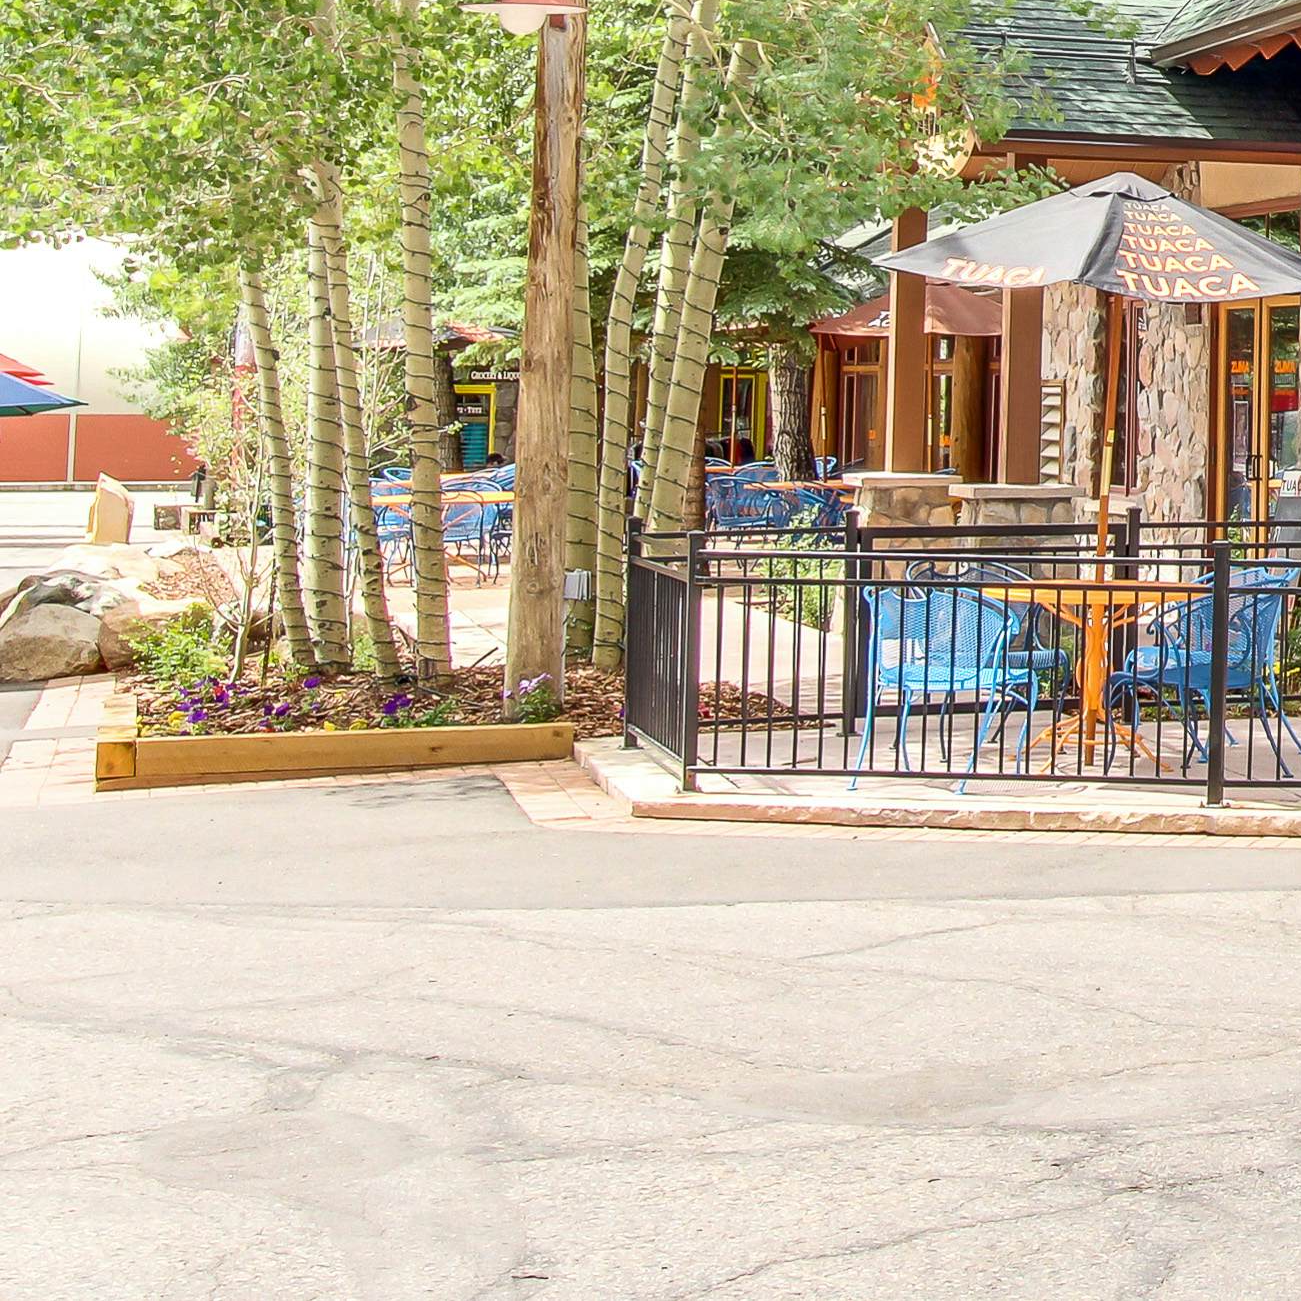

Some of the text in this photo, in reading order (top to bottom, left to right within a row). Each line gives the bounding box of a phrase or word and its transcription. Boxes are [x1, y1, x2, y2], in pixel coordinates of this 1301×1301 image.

[1124, 202, 1170, 211] TUACA
[1123, 210, 1182, 222] TUACA
[1123, 222, 1197, 236] TUACA
[1121, 234, 1215, 252] TUACA
[1118, 249, 1234, 273] TUACA
[941, 257, 1047, 285] TUACA
[1115, 269, 1260, 298] TUACA
